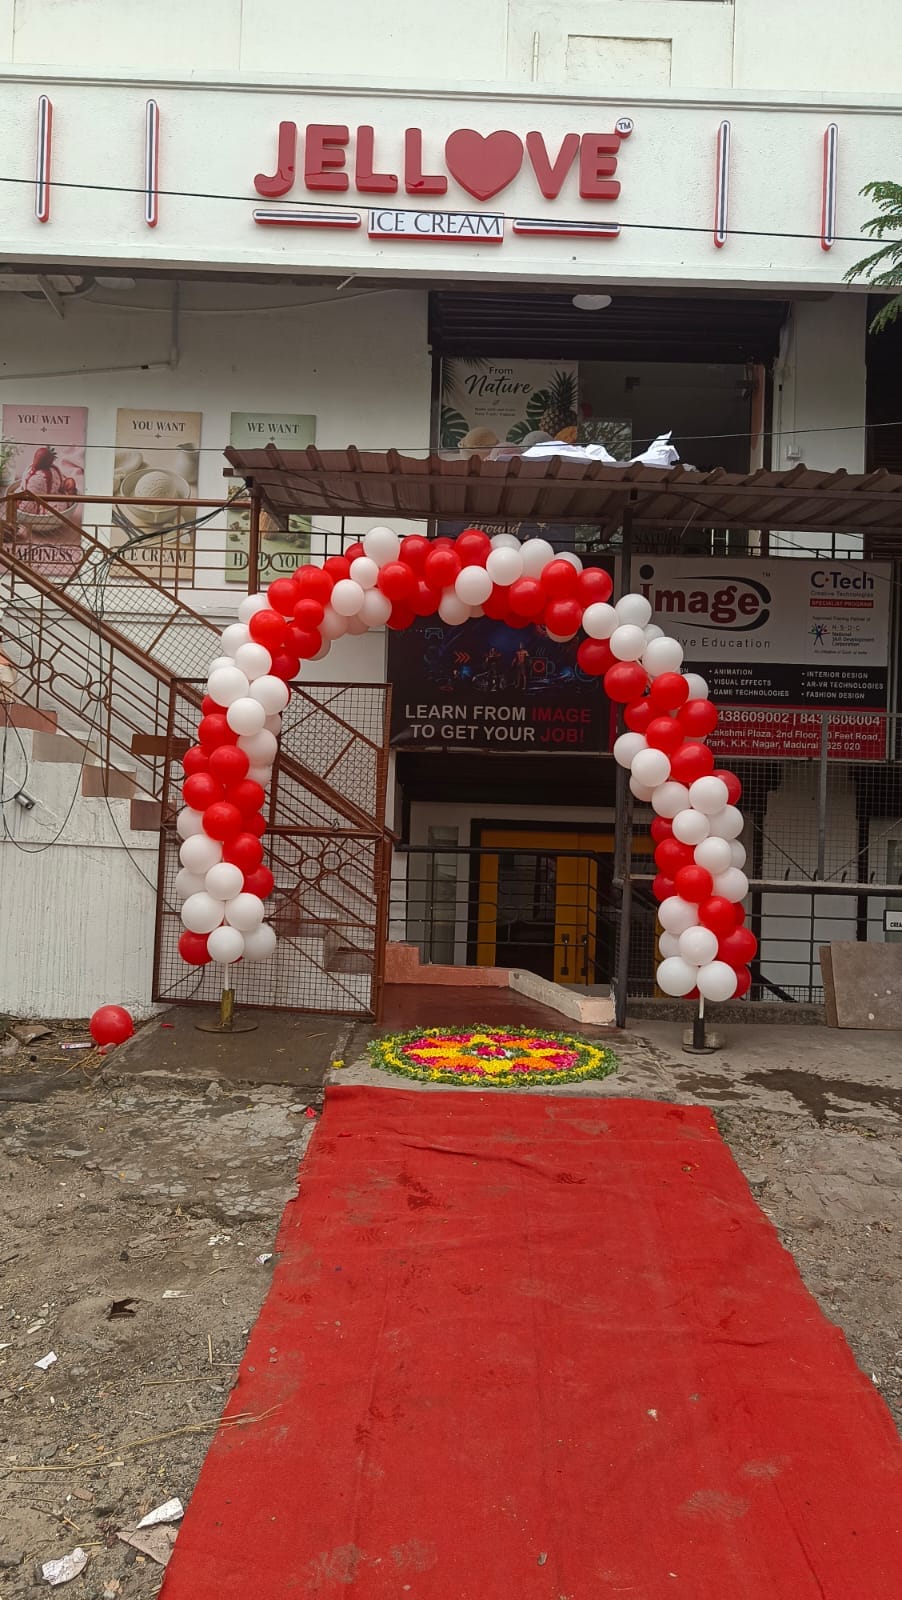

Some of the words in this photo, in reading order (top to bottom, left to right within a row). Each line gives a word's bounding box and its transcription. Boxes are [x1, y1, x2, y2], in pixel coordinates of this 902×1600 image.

[618, 122, 632, 130] TM
[370, 211, 405, 231] ICE
[414, 212, 500, 235] CREAM
[489, 366, 513, 375] From
[464, 374, 533, 397] Nature
[17, 414, 39, 425] YOU
[41, 414, 71, 425] WANT
[132, 420, 153, 431] YOU
[155, 421, 186, 432] WANT
[247, 422, 266, 433] WE
[268, 423, 301, 434] WANT
[5, 547, 73, 562] APPINESS
[116, 549, 138, 561] CE
[702, 637, 771, 648] Education
[830, 682, 884, 690] TECHNOLOGIES
[735, 689, 790, 697] TECHNOLOGIES
[405, 704, 467, 719] LEARN
[473, 705, 526, 721] FROM
[532, 707, 592, 722] IMAGE
[718, 710, 790, 723] 438609002
[410, 724, 435, 739] TO
[441, 725, 478, 740] GET
[483, 726, 536, 742] YOUR
[540, 727, 584, 743] JOB!
[747, 729, 774, 738] Plaza,
[776, 730, 793, 738] 2nd
[795, 731, 819, 740] Floor,
[834, 732, 853, 740] Feet
[855, 732, 881, 742] Road,
[706, 739, 729, 748] Park,
[752, 739, 781, 749] Nagar,
[783, 740, 819, 749] Madurai
[843, 742, 860, 750] 020
